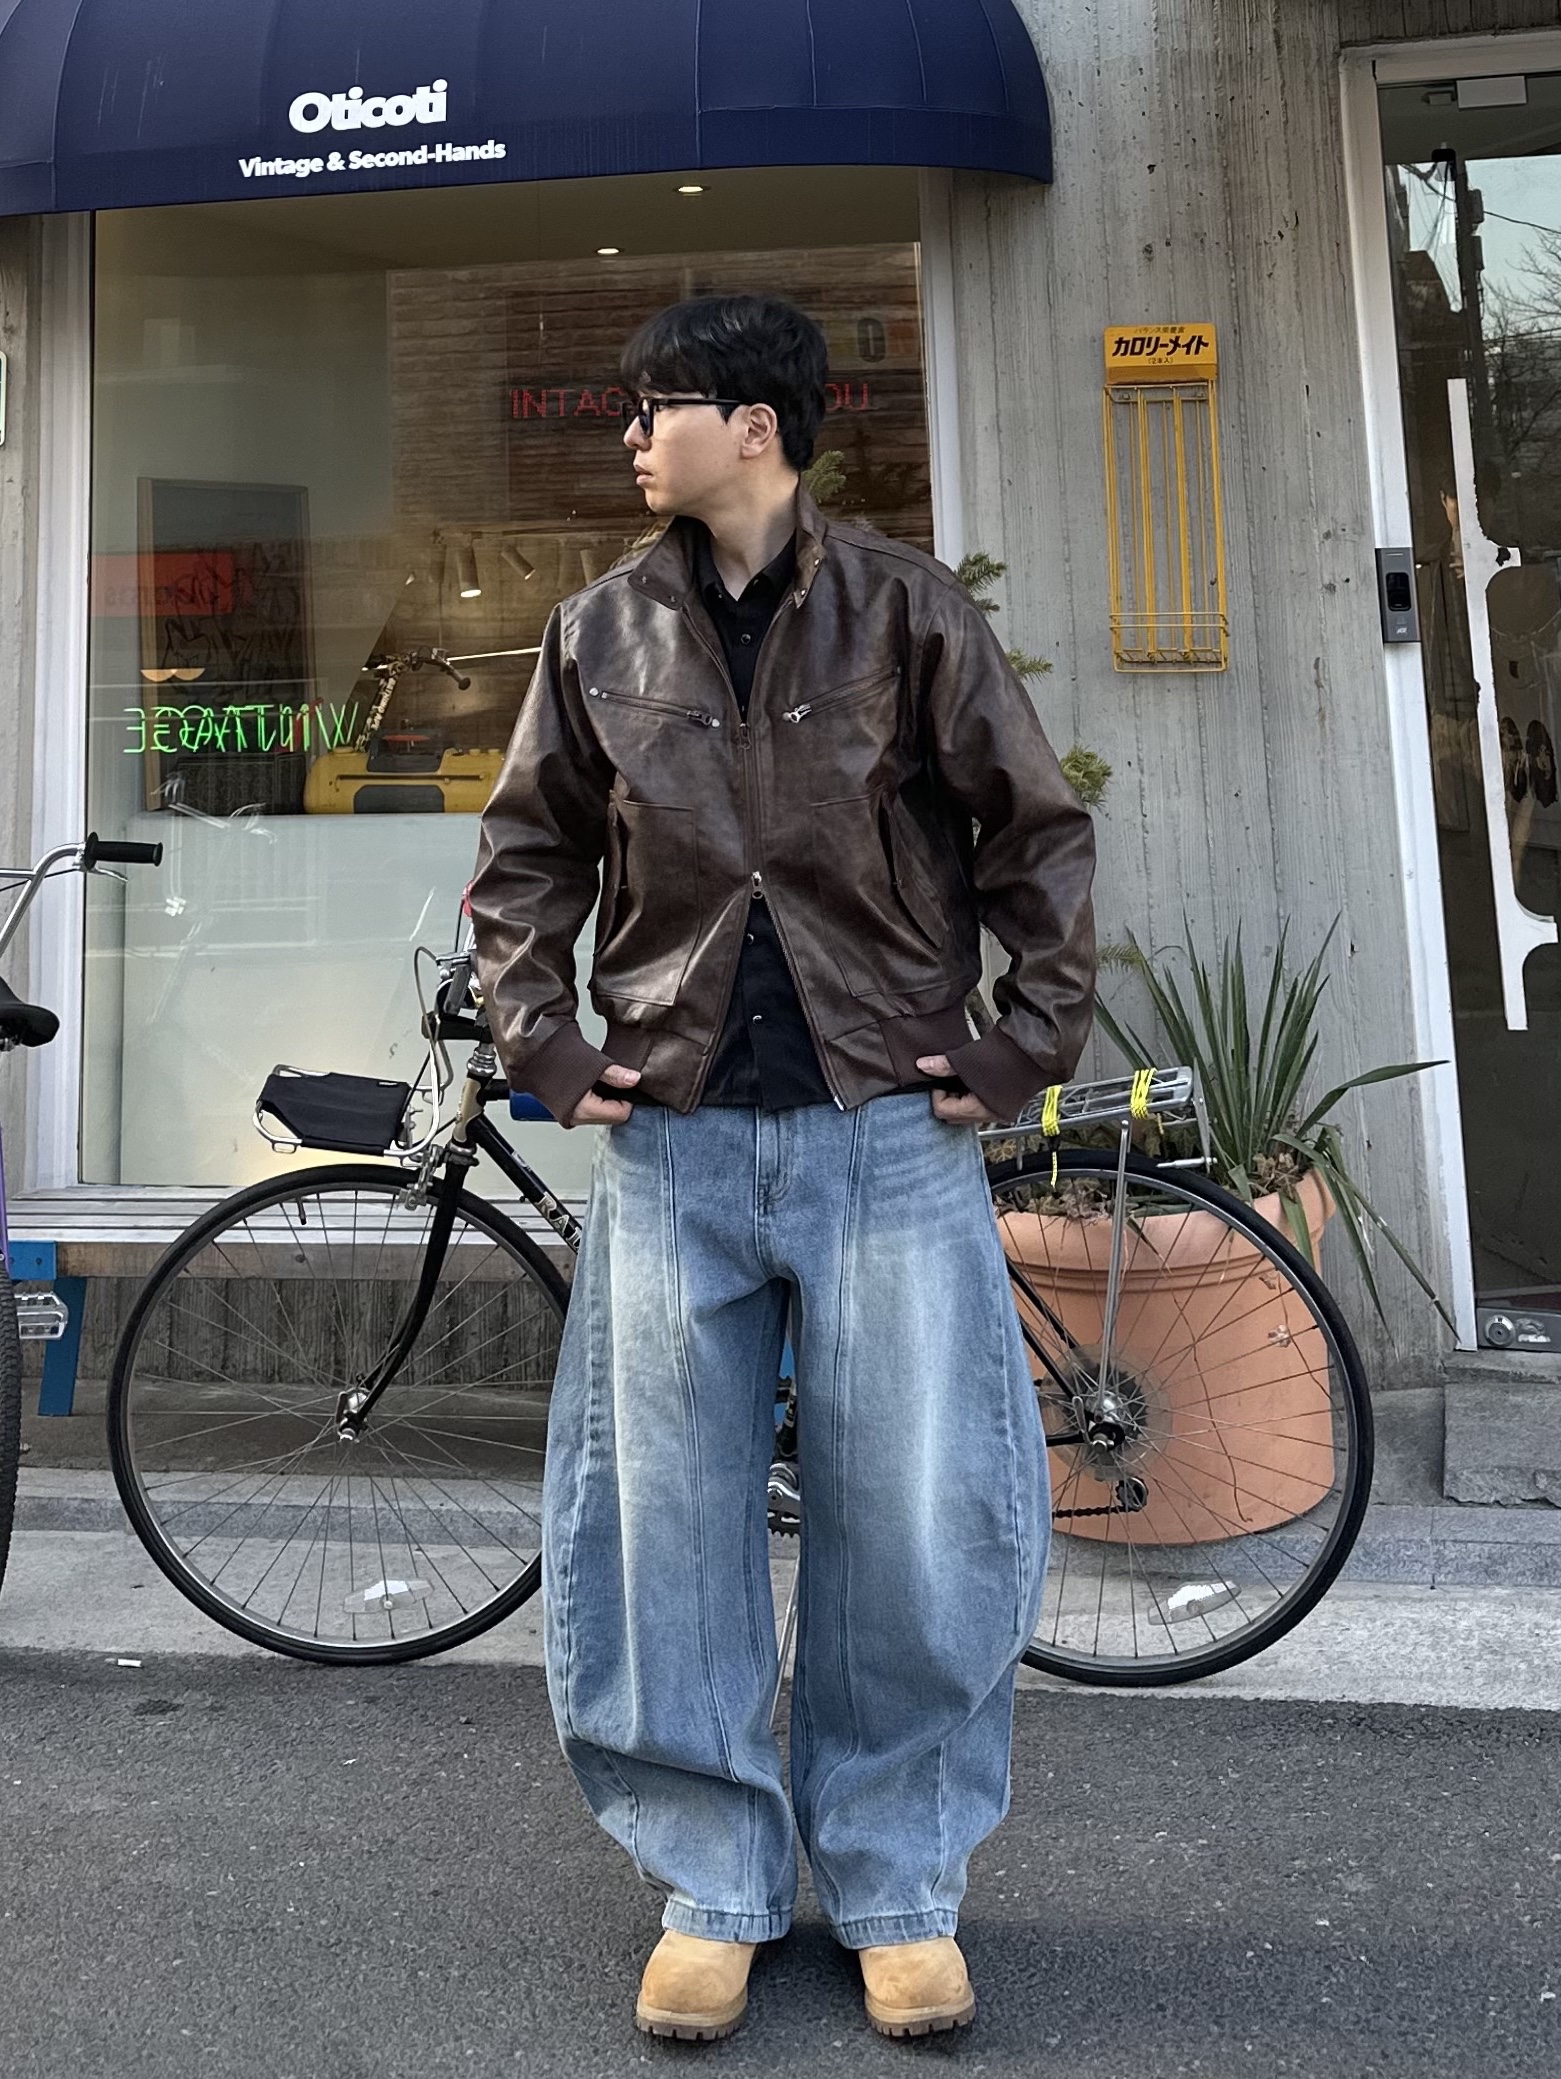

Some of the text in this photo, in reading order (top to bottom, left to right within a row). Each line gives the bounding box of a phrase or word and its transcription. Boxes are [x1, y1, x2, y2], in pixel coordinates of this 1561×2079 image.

[289, 79, 448, 133] Oticoti
[239, 139, 507, 178] Vintage & Second-Hands
[1112, 335, 1210, 357] カロリーメイト
